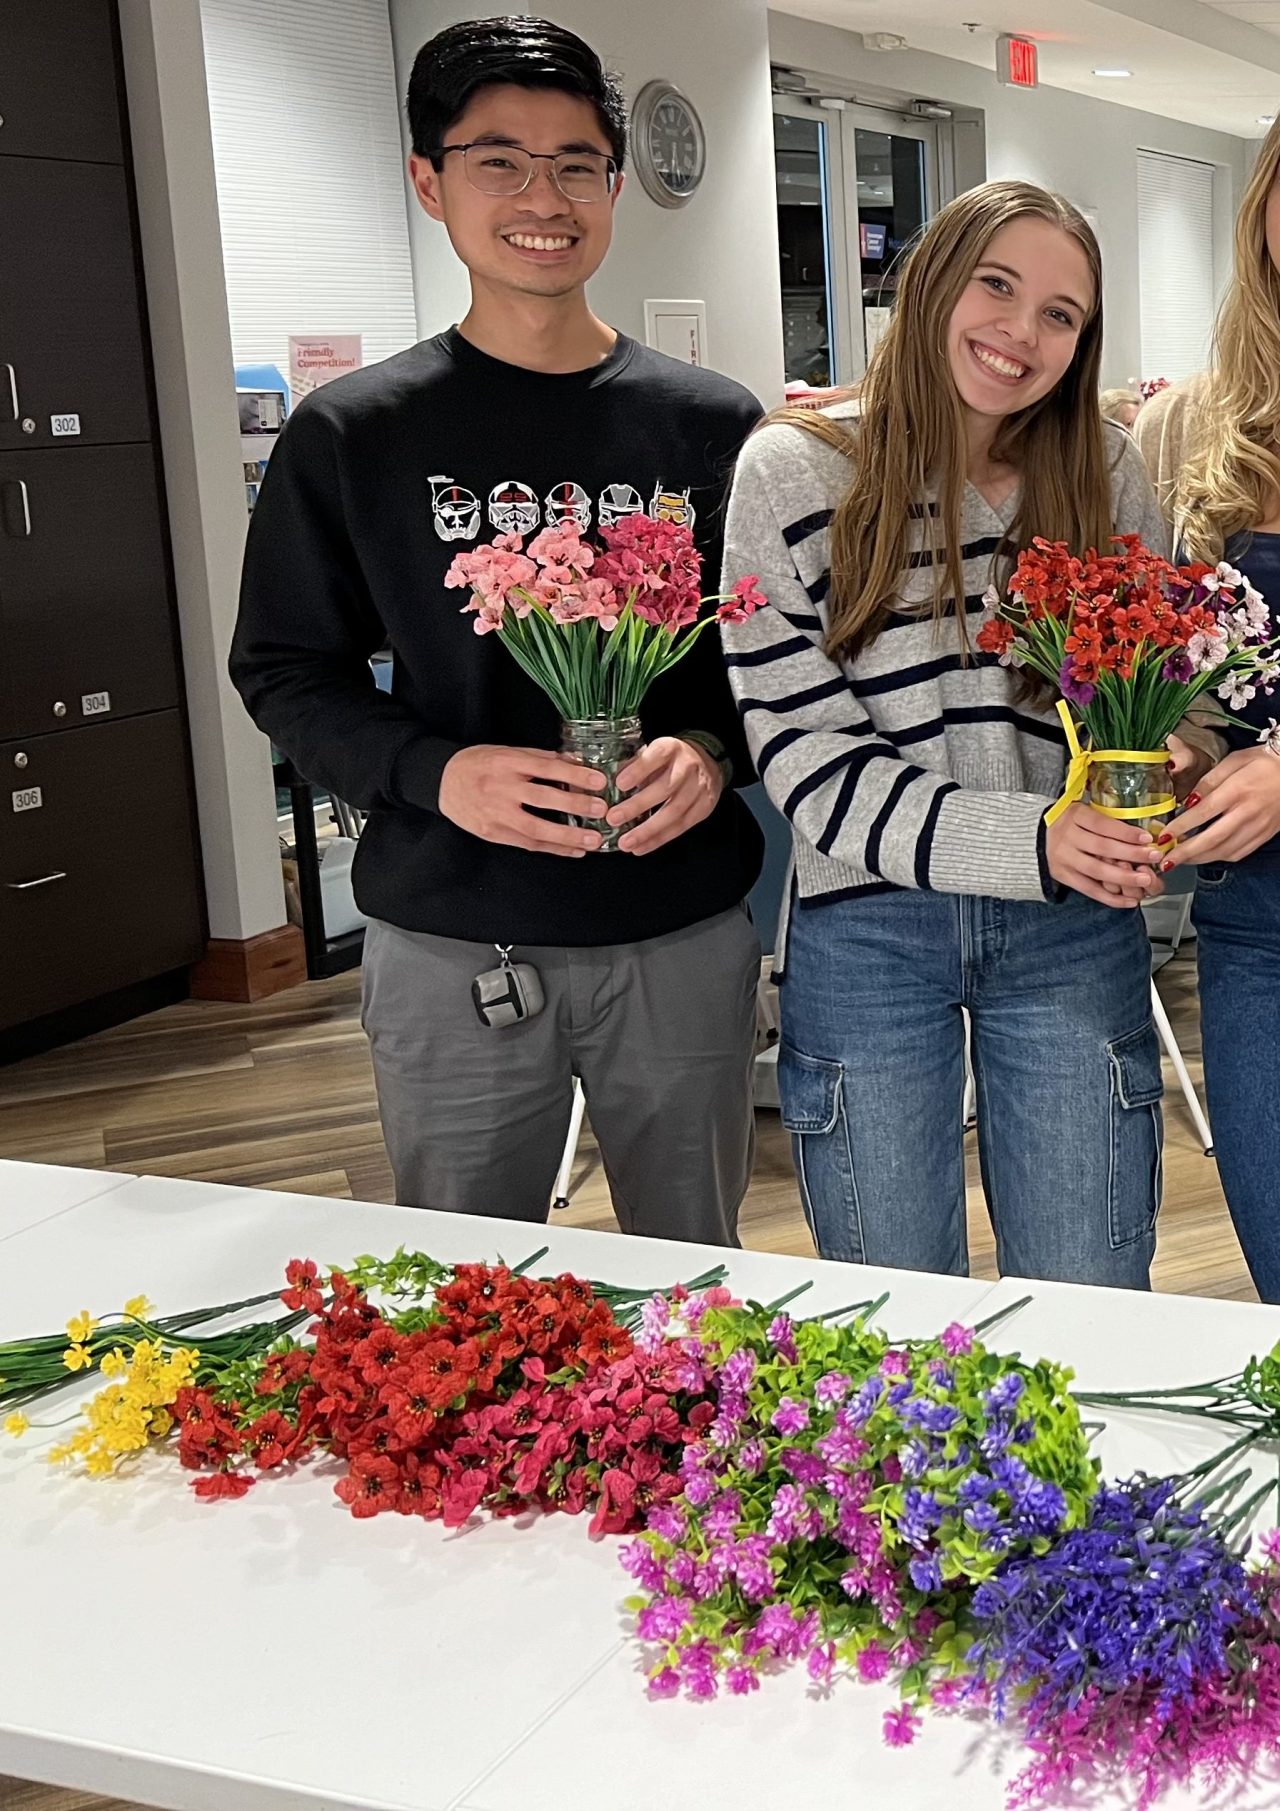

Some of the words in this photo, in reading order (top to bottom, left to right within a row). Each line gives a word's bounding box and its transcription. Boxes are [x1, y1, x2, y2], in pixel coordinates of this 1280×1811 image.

[297, 358, 355, 369] Competition!
[54, 417, 77, 432] 302
[85, 695, 106, 711] 304
[15, 790, 38, 807] 306
